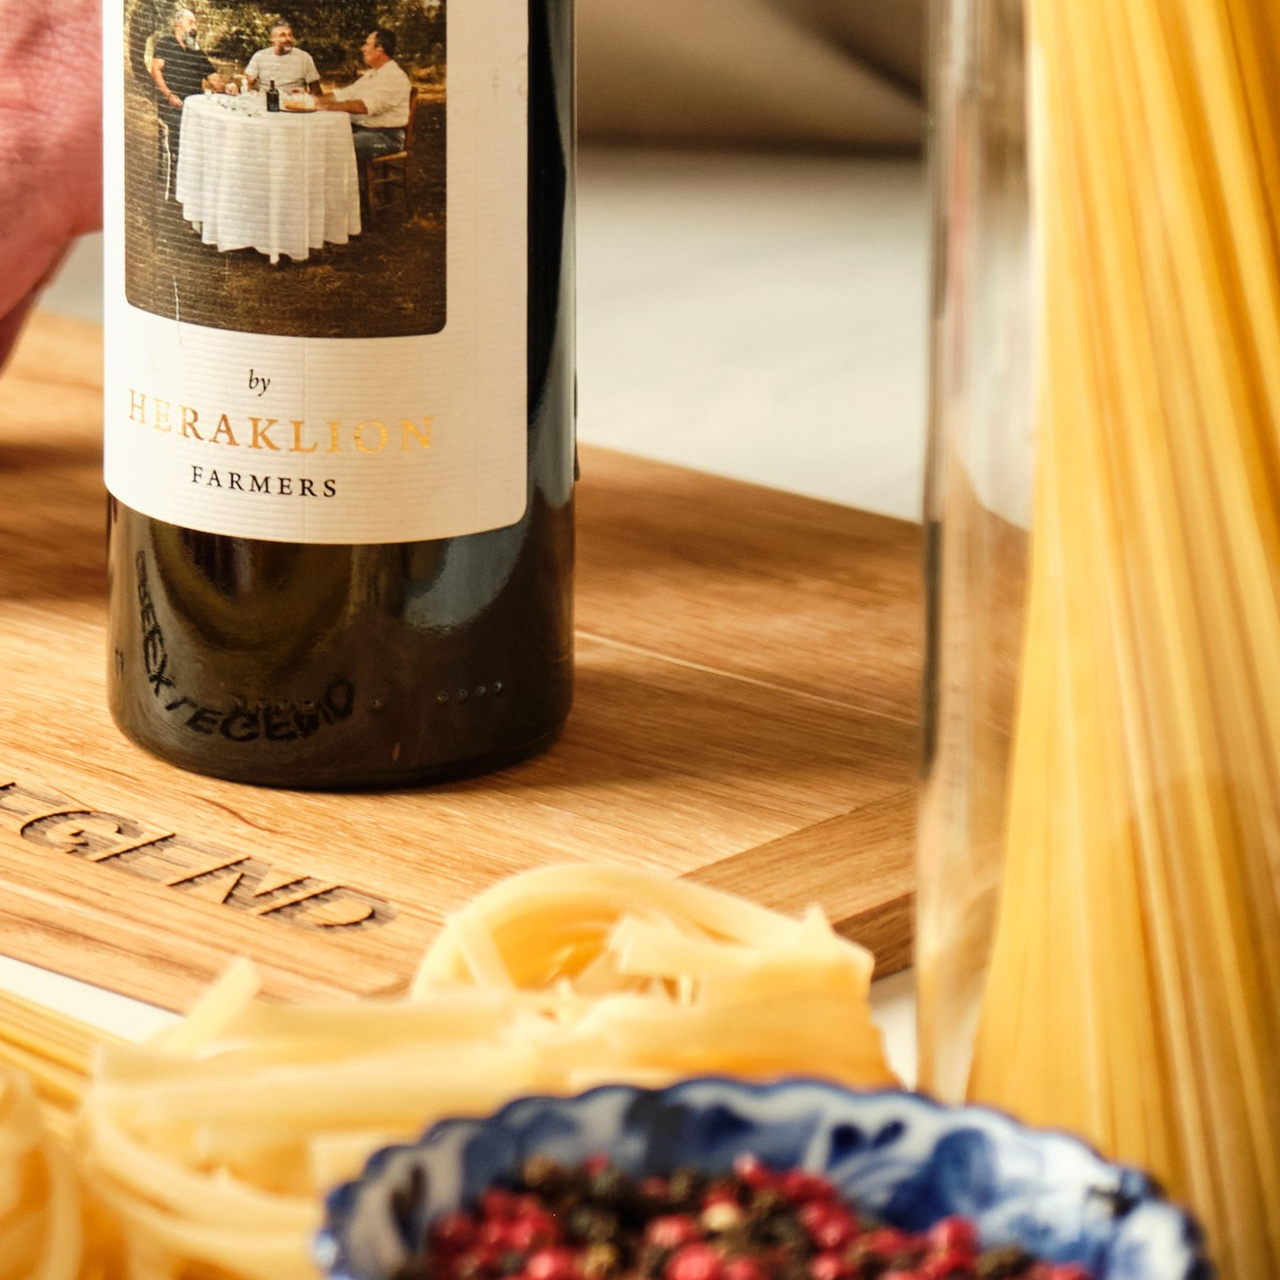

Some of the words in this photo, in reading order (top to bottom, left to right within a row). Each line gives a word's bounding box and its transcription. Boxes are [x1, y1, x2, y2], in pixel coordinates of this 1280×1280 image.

[248, 370, 271, 396] by
[129, 389, 435, 454] HERAKLION
[192, 465, 338, 498] FARMERS
